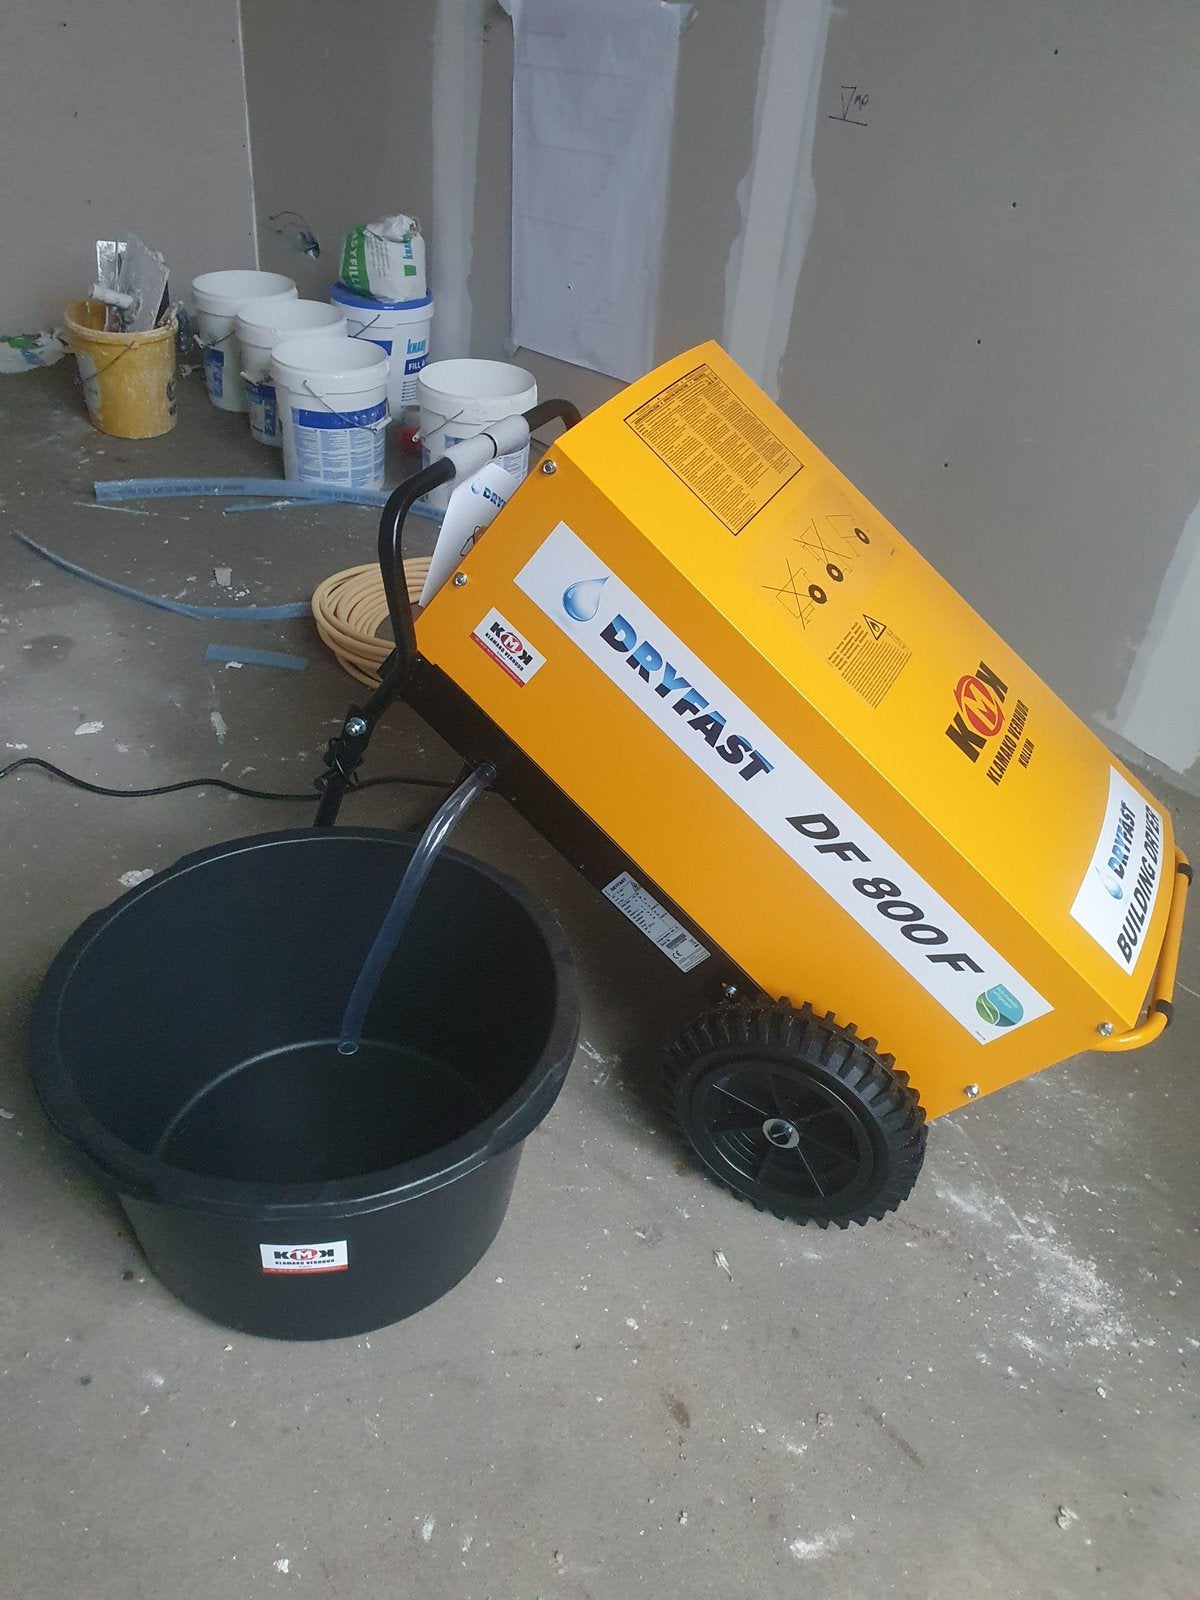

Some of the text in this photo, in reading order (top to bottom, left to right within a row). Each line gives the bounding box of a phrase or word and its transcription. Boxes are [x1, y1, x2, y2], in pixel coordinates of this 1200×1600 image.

[408, 361, 421, 372] FILL
[986, 699, 1029, 786] KLAMAKO VERHUUR
[1018, 737, 1035, 769] KOLLUM
[599, 614, 775, 781] DRYFAST
[785, 813, 872, 863] DF
[852, 877, 949, 946] 800
[925, 952, 985, 974] F
[1107, 800, 1136, 880] DRYFAST
[1117, 804, 1160, 964] BUILDING DRYER
